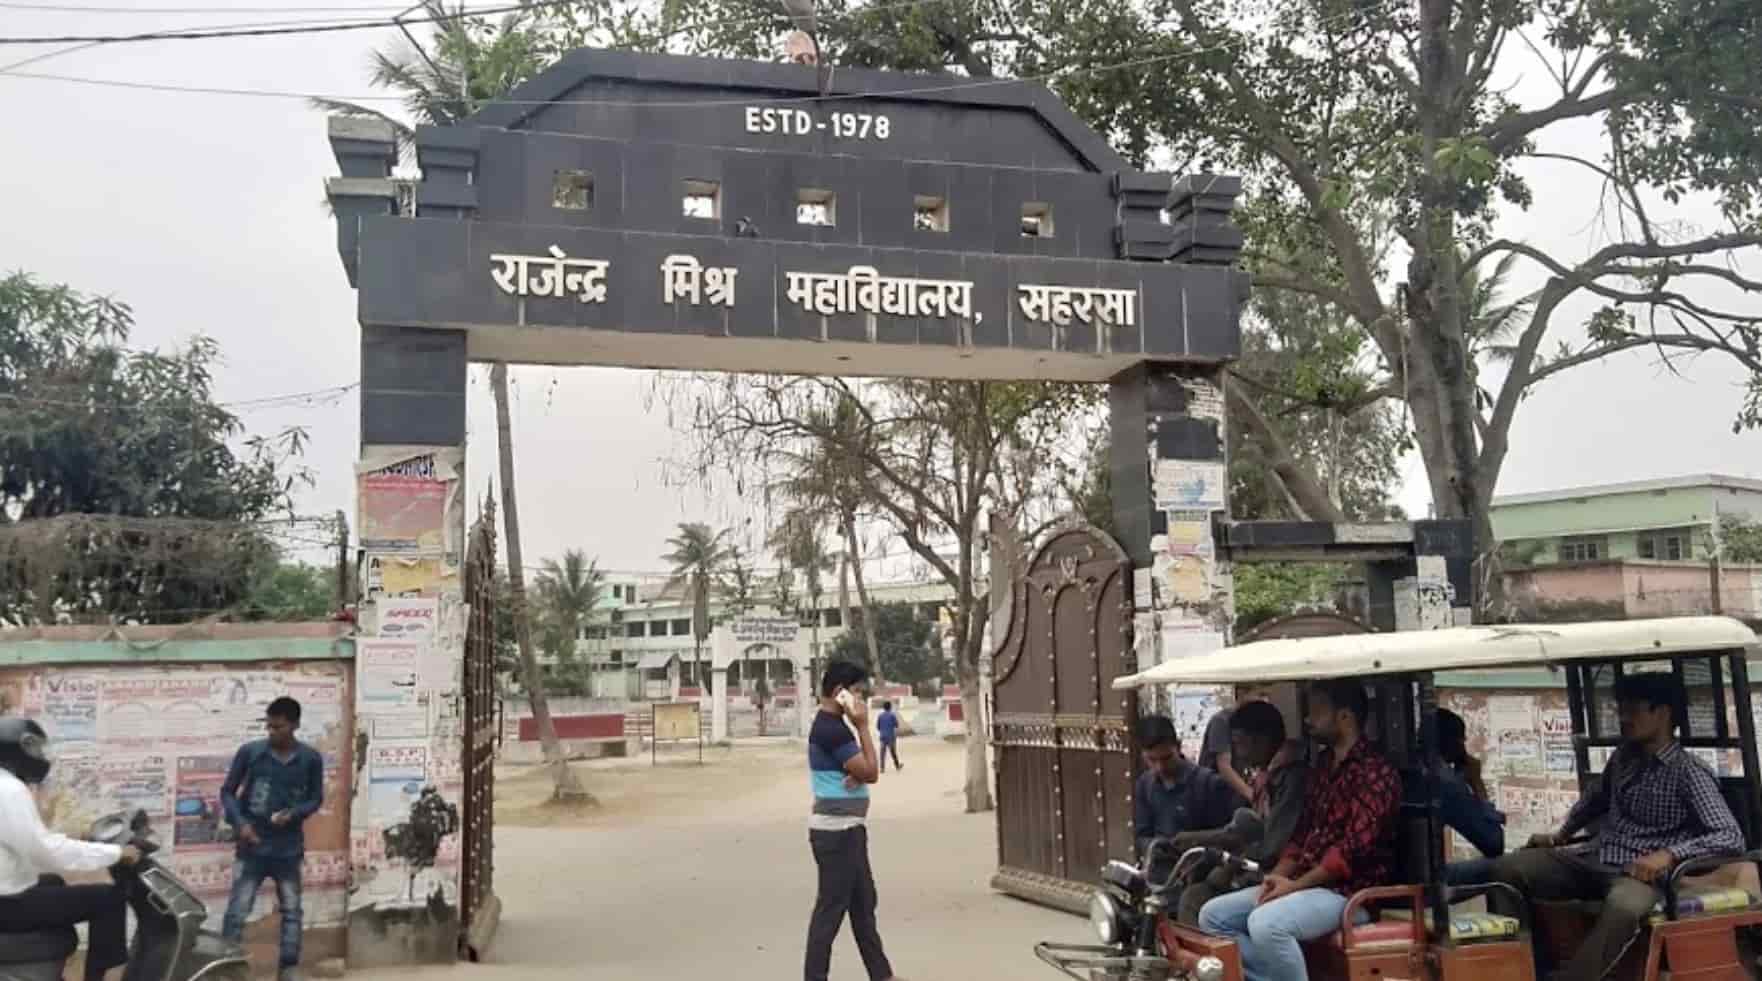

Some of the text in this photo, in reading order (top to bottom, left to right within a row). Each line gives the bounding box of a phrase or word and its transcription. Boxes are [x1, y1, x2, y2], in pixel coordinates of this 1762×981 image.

[490, 245, 1137, 326] राजेन्द्र मिश्र महाविद्यालय, सहरसा
